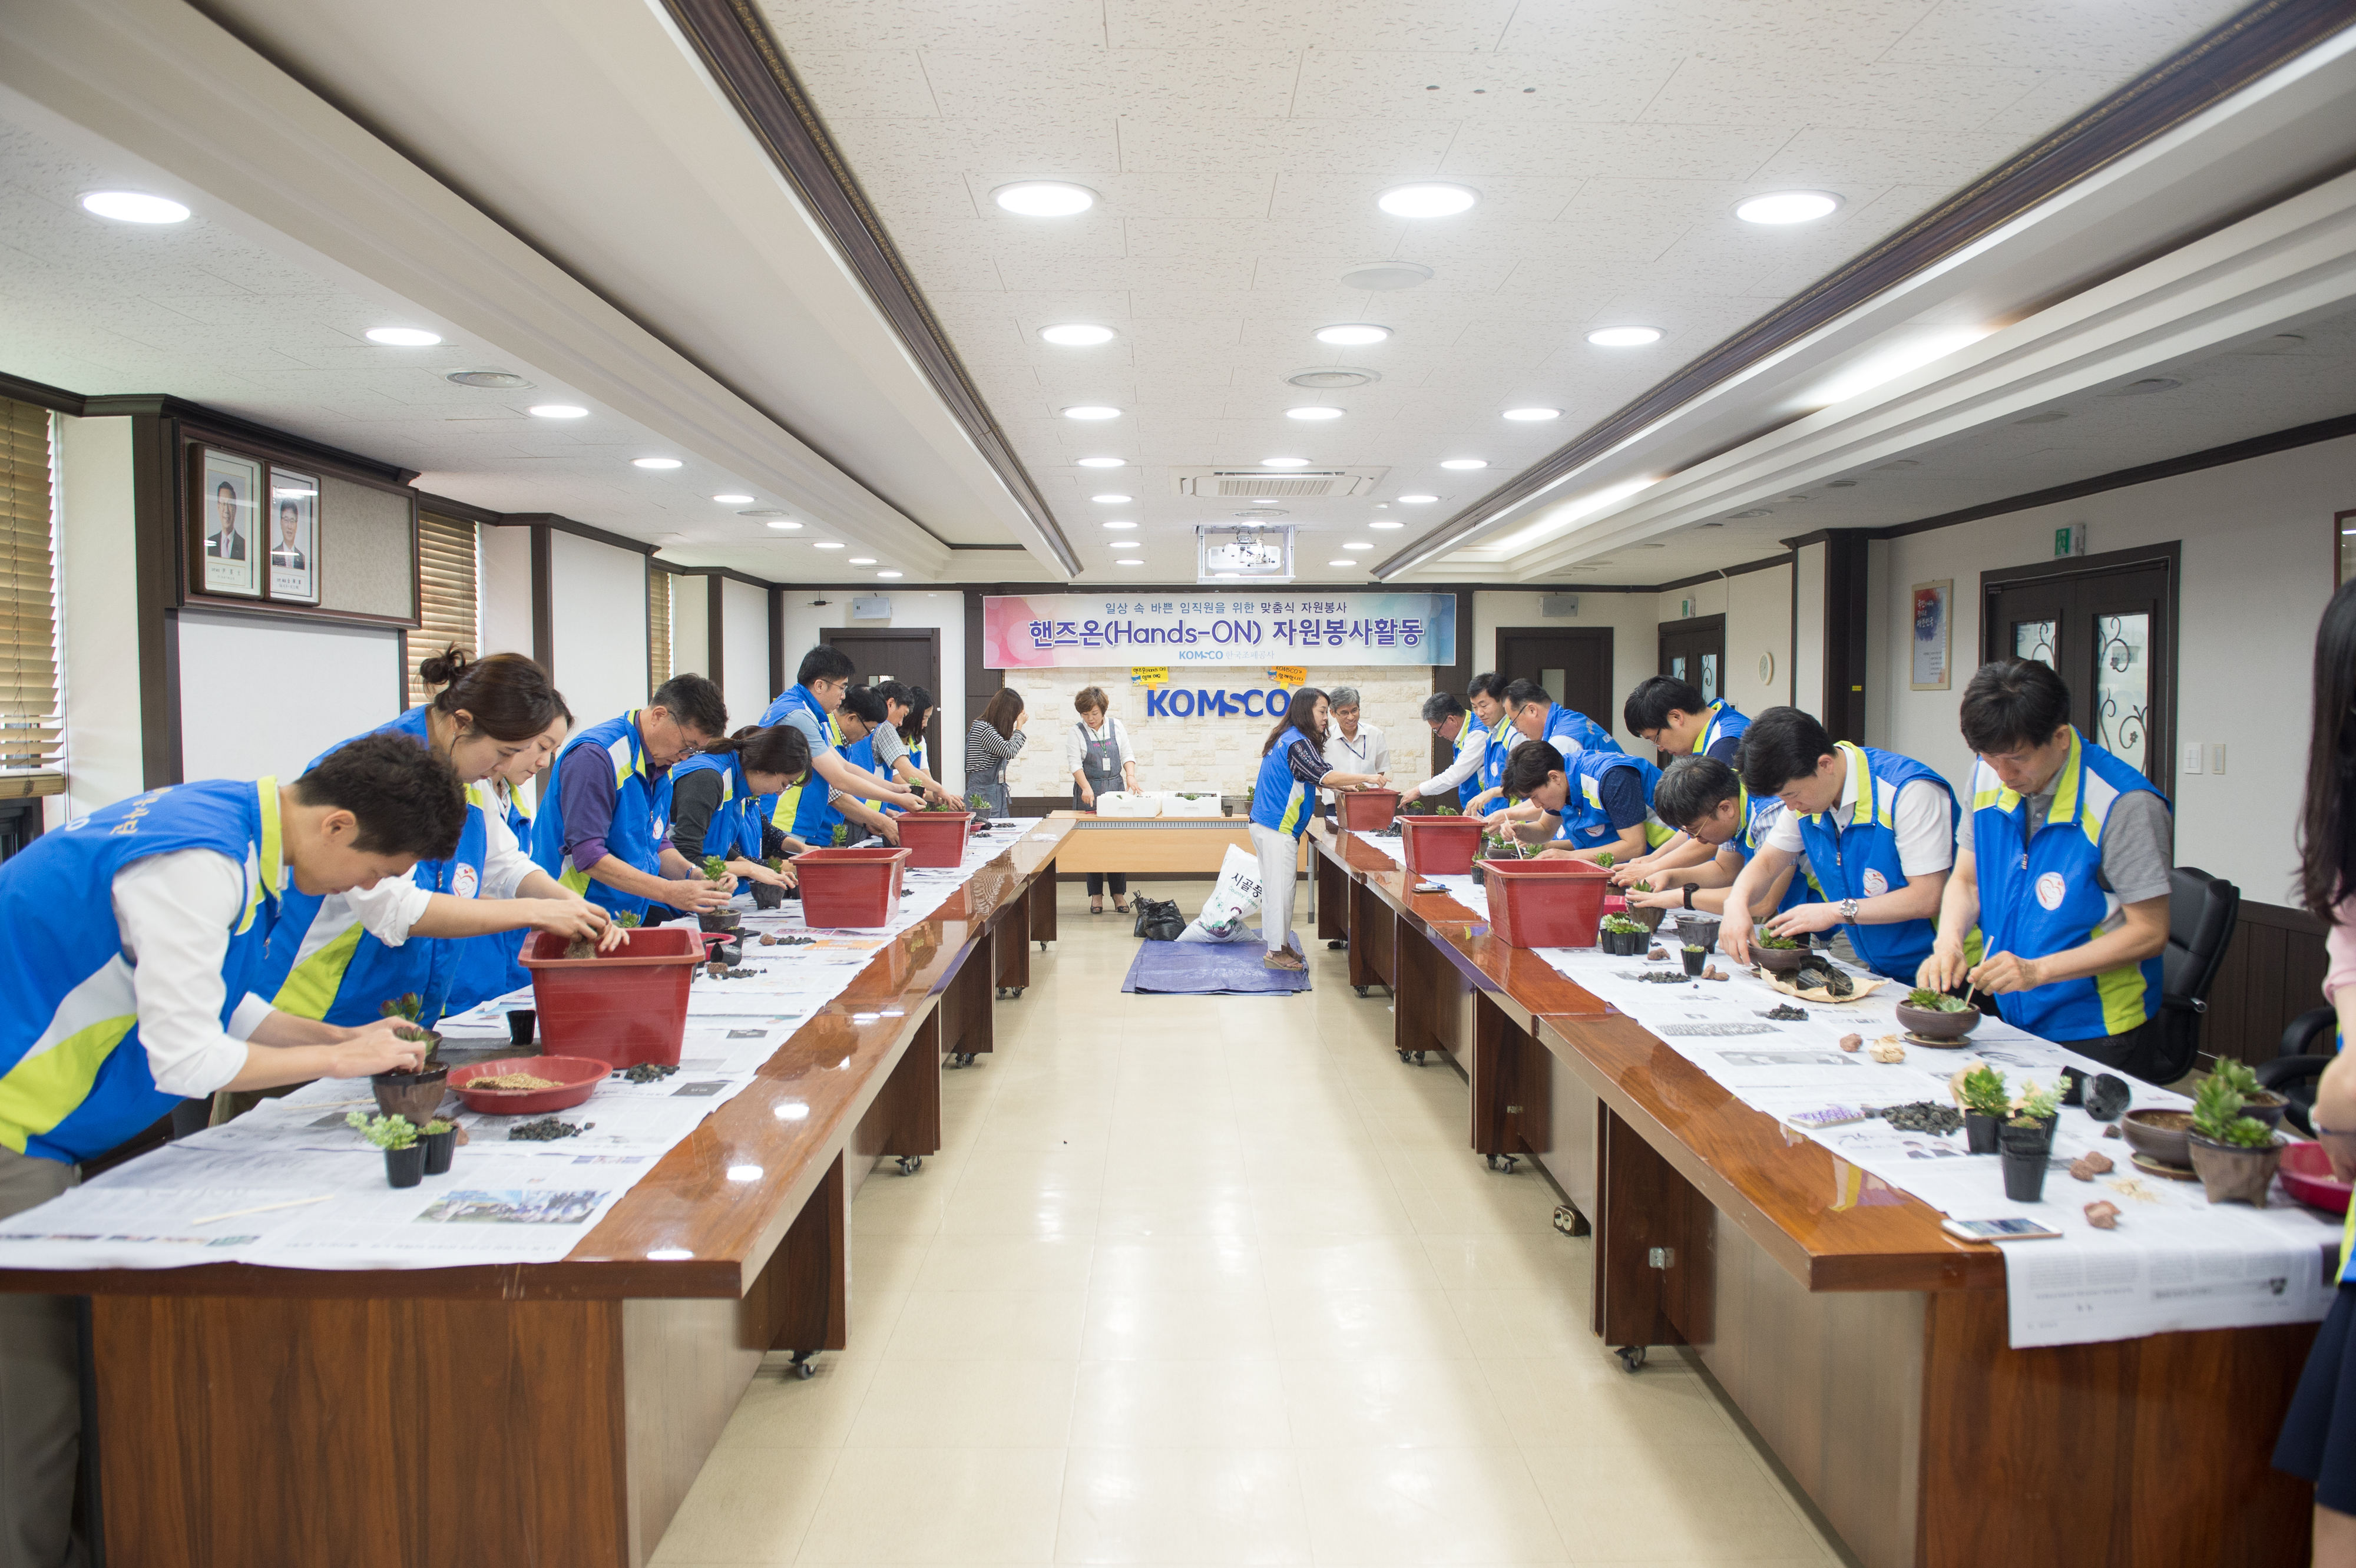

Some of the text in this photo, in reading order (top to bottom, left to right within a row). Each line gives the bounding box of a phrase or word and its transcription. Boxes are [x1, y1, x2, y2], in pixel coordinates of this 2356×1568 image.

[1106, 601, 1347, 614] 일상 속 바쁜 임직원을 위한 맞춤식 자원봉사
[1030, 618, 1424, 647] 핸즈온(Hands-ON) 자원봉사활동
[1179, 650, 1275, 660] KOMSCO 한국조폐공사
[1147, 689, 1291, 717] KOMSCO
[1231, 872, 1262, 903] 시골풍
